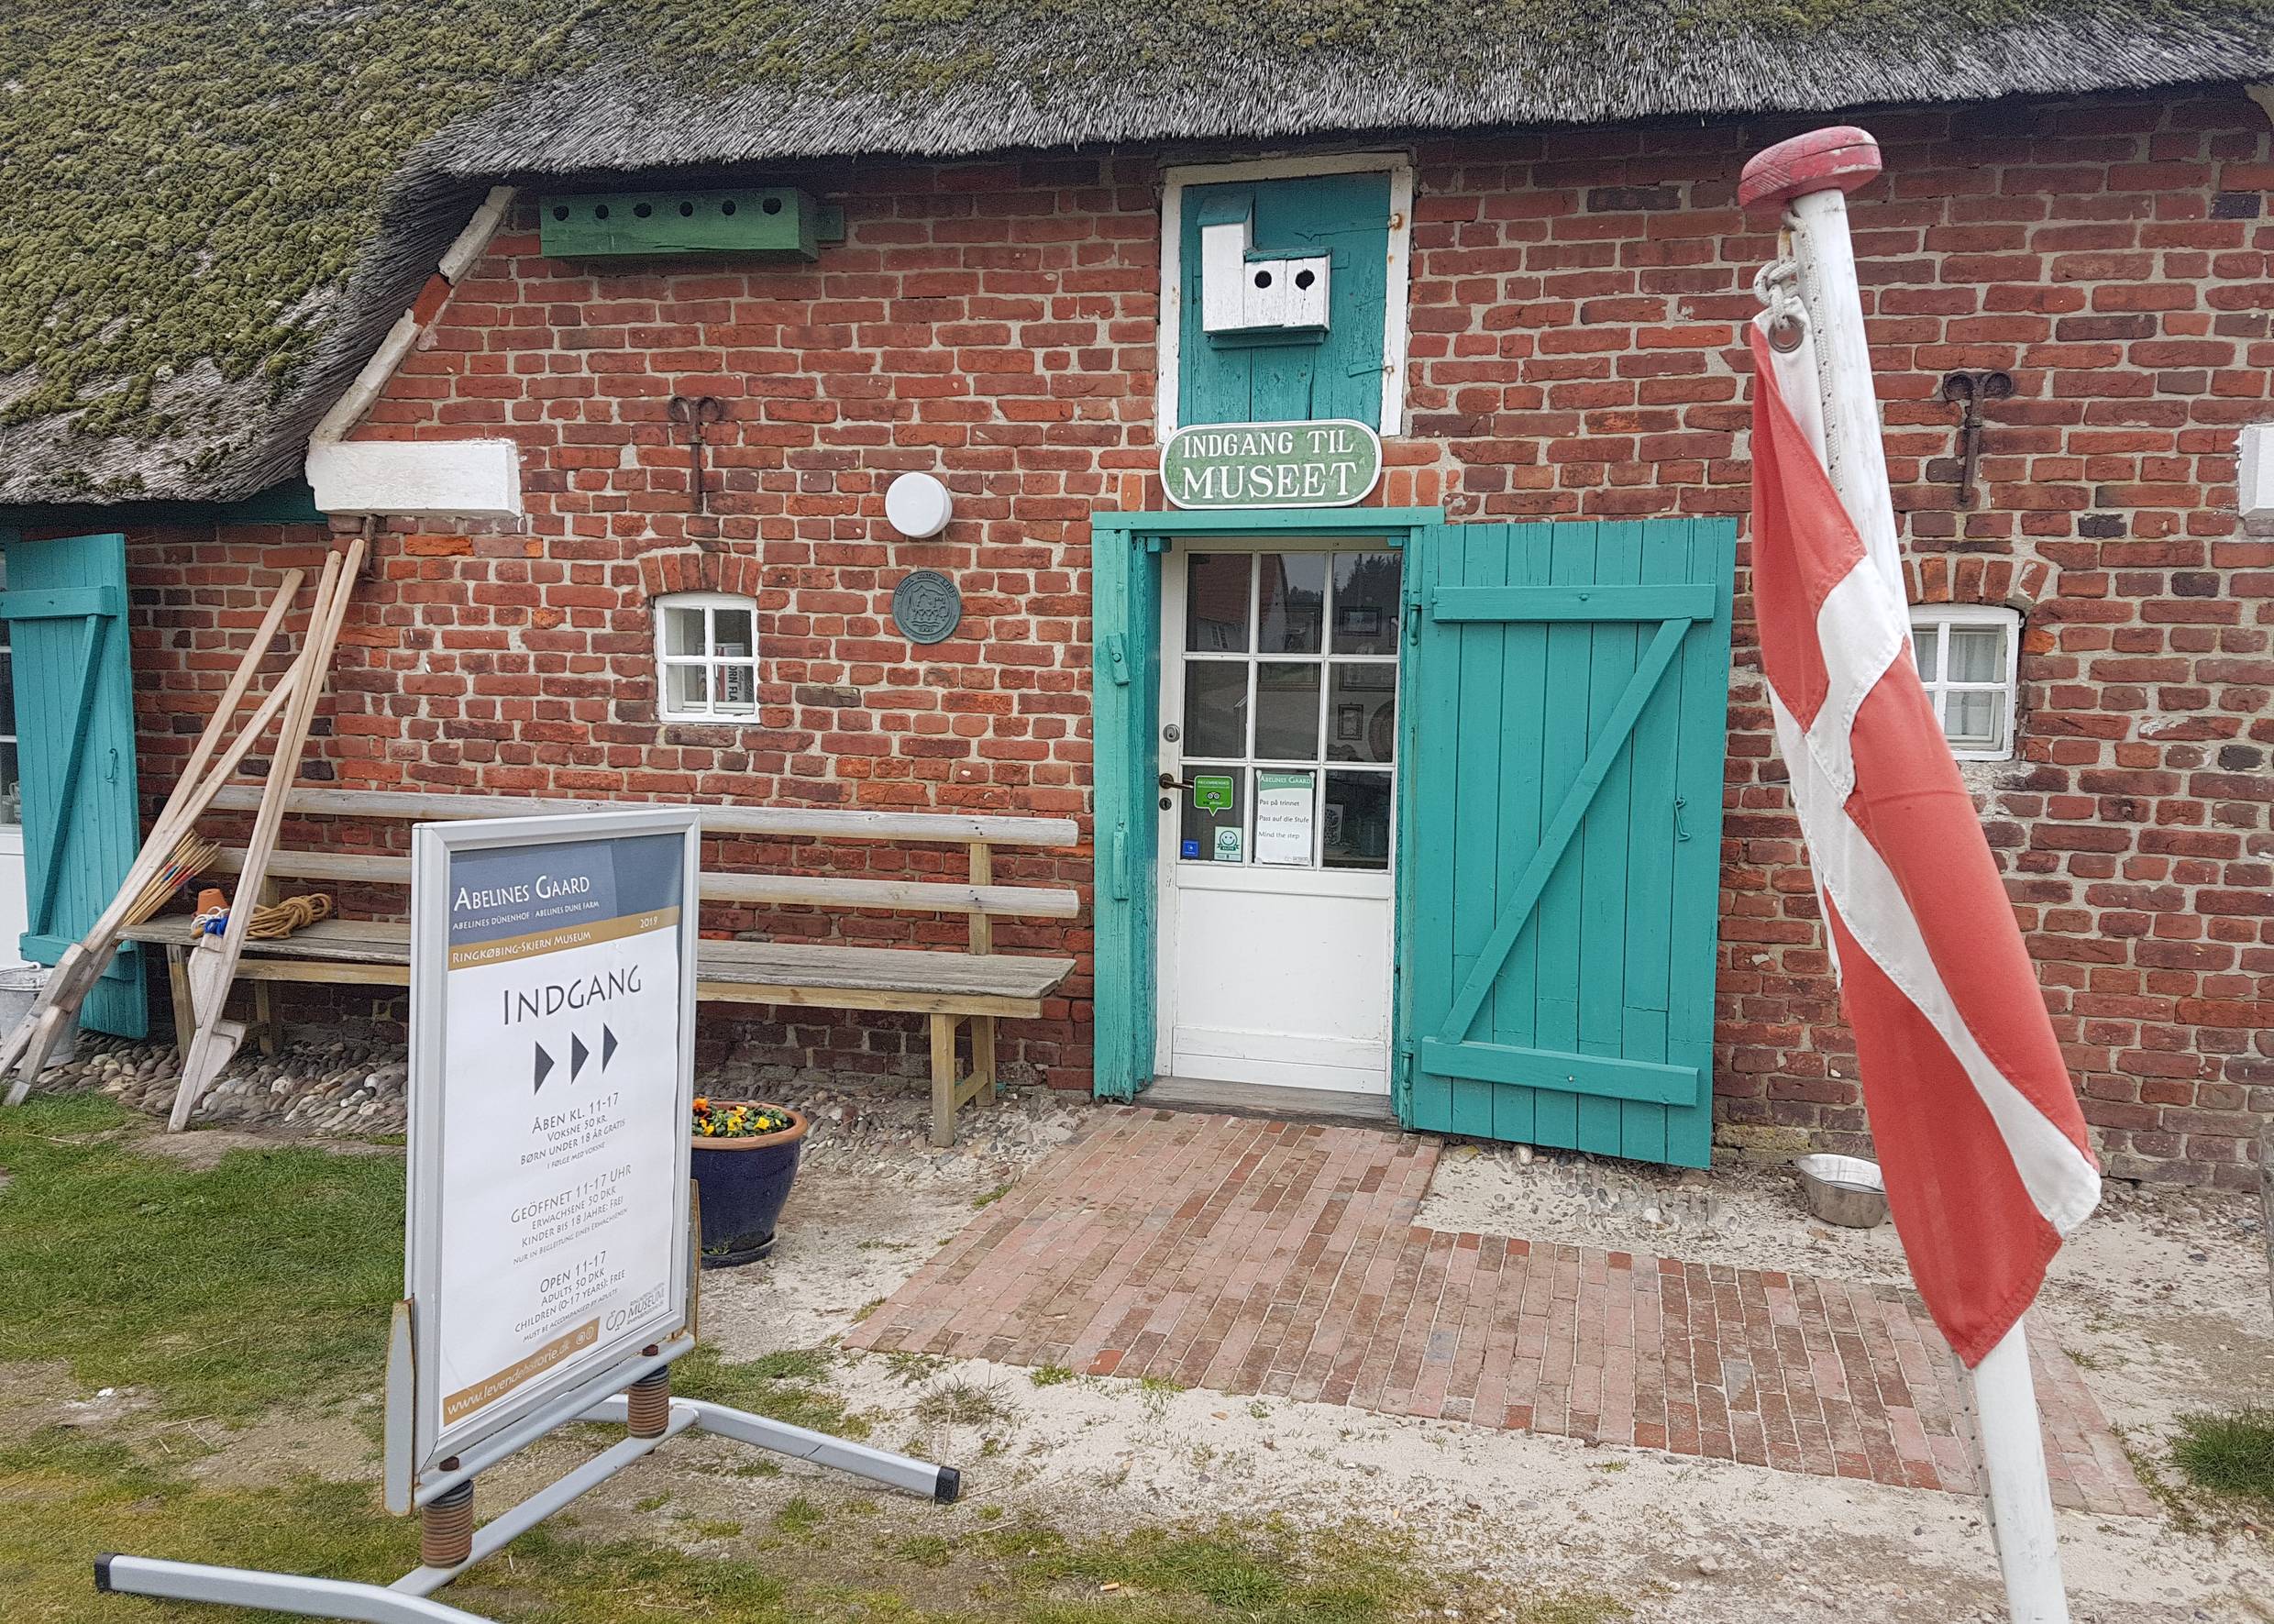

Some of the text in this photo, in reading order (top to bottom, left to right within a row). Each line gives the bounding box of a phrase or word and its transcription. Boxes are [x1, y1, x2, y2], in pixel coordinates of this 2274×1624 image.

[1183, 429, 1353, 458] INDGANG TIL
[1182, 461, 1357, 501] MUSEET
[1287, 833, 1300, 841] step
[453, 875, 591, 911] ABELINES GAARD
[452, 900, 600, 930] ABELINES DÜNENHOF ABELINES DUNE FARM
[452, 915, 658, 964] RINGKØBING-SKJERN MUSEUM 2019
[503, 965, 642, 1025] INDGANG
[532, 1092, 619, 1134] ÅBEN KL. 11-17
[547, 1124, 581, 1142] VOKSNE
[583, 1119, 594, 1130] 50
[521, 1119, 625, 1165] BØRN UNDER 18 ÅR GRATIS
[570, 1151, 584, 1161] MED
[511, 1165, 632, 1223] GEÖFFNET 11-17 UHR
[532, 1186, 616, 1231] ERWACHSENE 50 DKK
[521, 1196, 624, 1247] KINDER BIS 18 JAHRE: FREI
[513, 1254, 528, 1265] NUR
[530, 1250, 537, 1259] IN
[540, 1251, 607, 1293] OPEN 11-17
[514, 1304, 557, 1333] CHILDREN
[557, 1292, 580, 1311] (0-17
[610, 1269, 625, 1284] FREE
[541, 1267, 605, 1306] ADULTS 50 DKK
[628, 1287, 665, 1319] MUSEUM
[523, 1330, 541, 1342] MUST
[541, 1325, 549, 1335] BE
